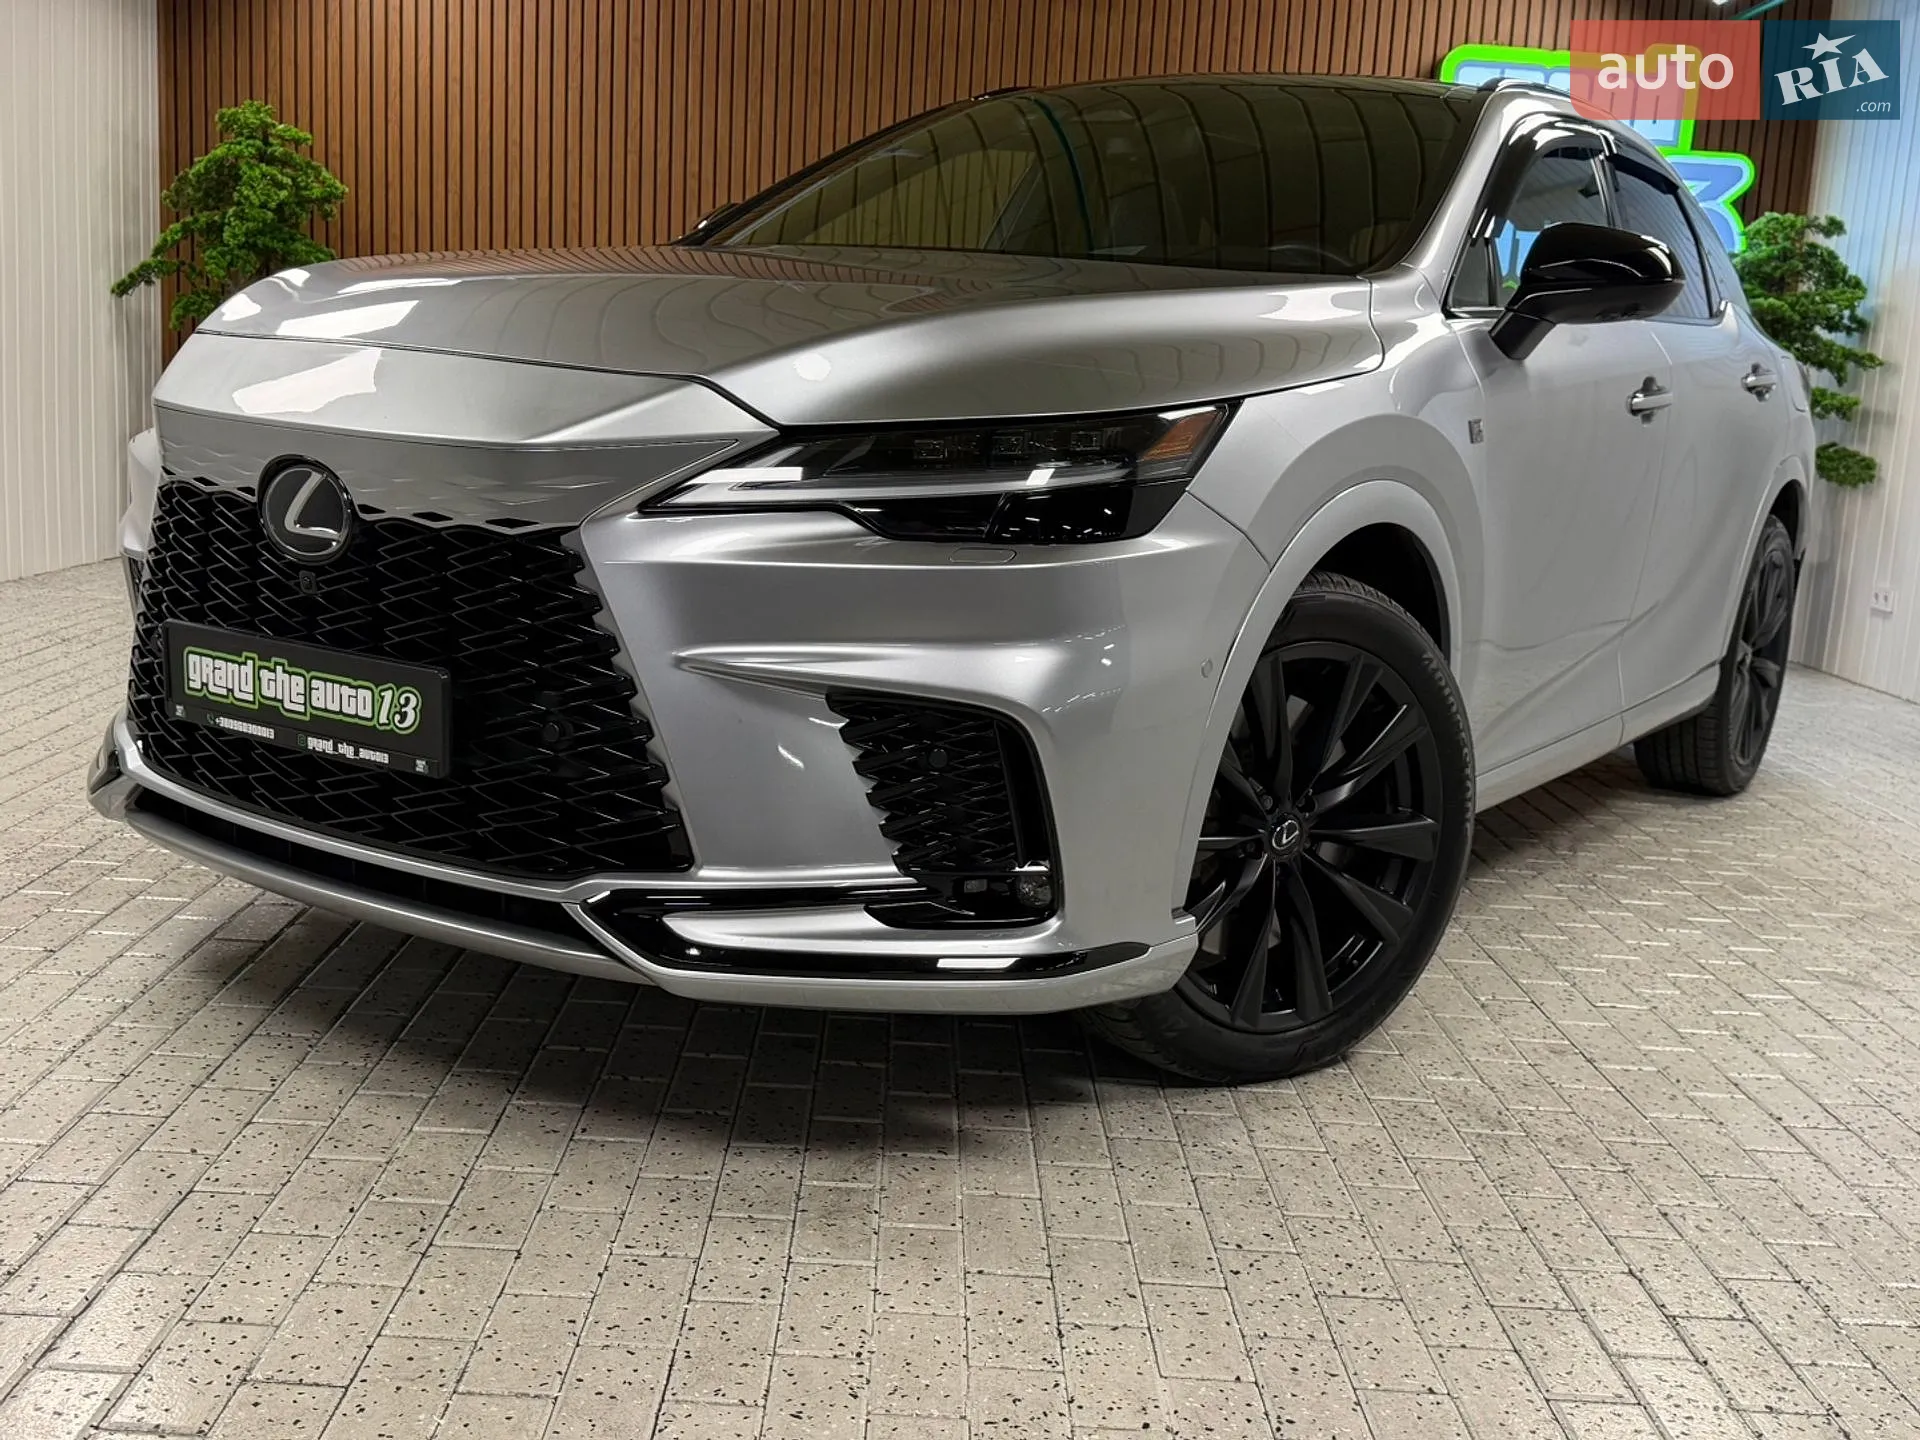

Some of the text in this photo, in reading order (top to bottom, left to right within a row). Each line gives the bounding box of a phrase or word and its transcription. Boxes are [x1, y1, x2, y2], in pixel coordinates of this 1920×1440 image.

[188, 653, 417, 728] grand the auto 13
